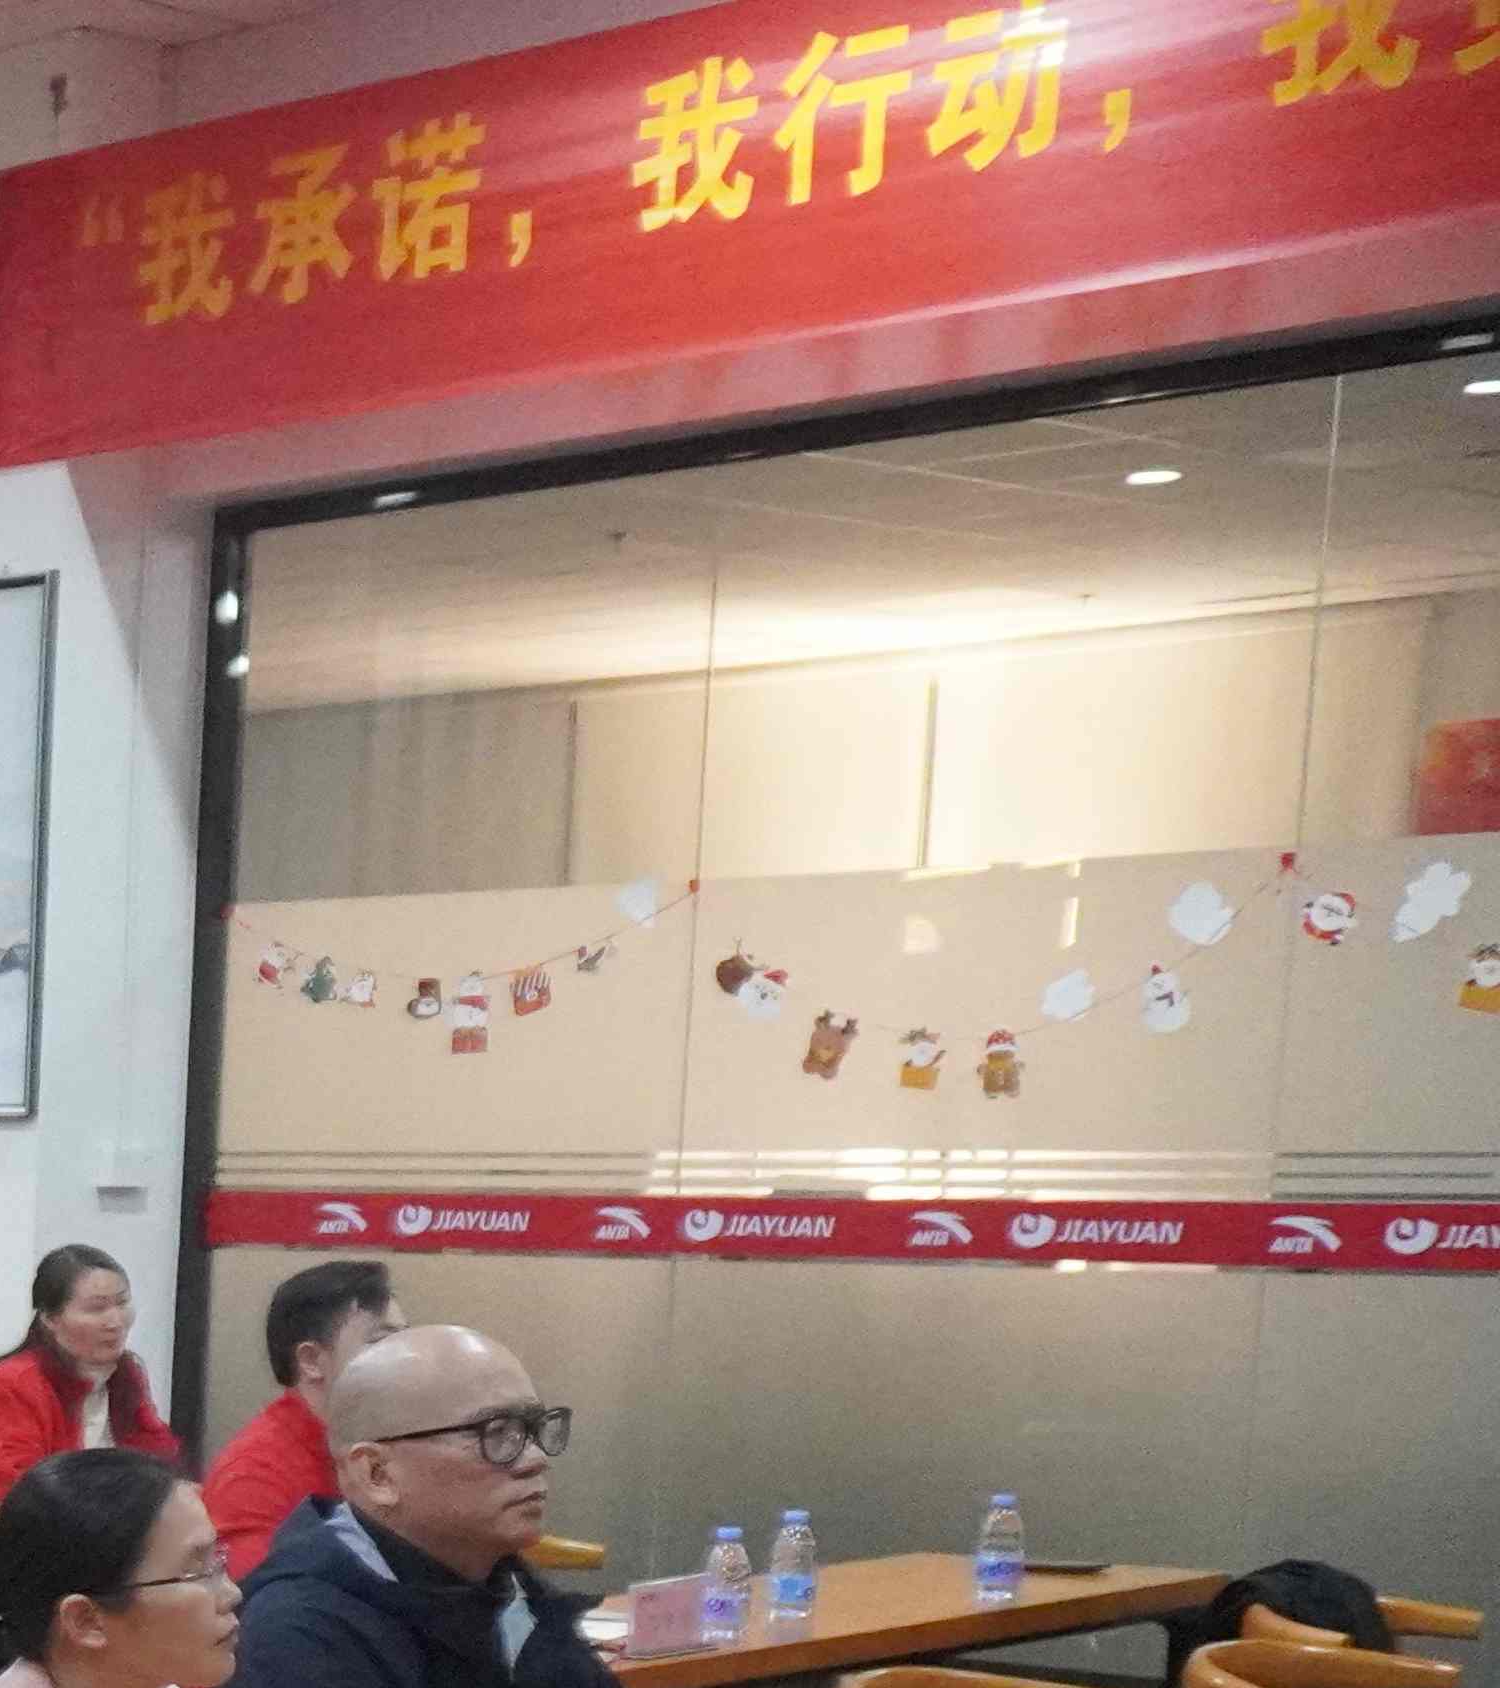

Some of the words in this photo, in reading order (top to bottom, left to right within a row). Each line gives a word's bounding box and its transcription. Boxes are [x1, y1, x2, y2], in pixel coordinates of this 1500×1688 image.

[432, 1209, 530, 1233] JIAYUAN
[723, 1214, 835, 1240] JIAYUAN
[1056, 1220, 1184, 1245] JIAYUAN
